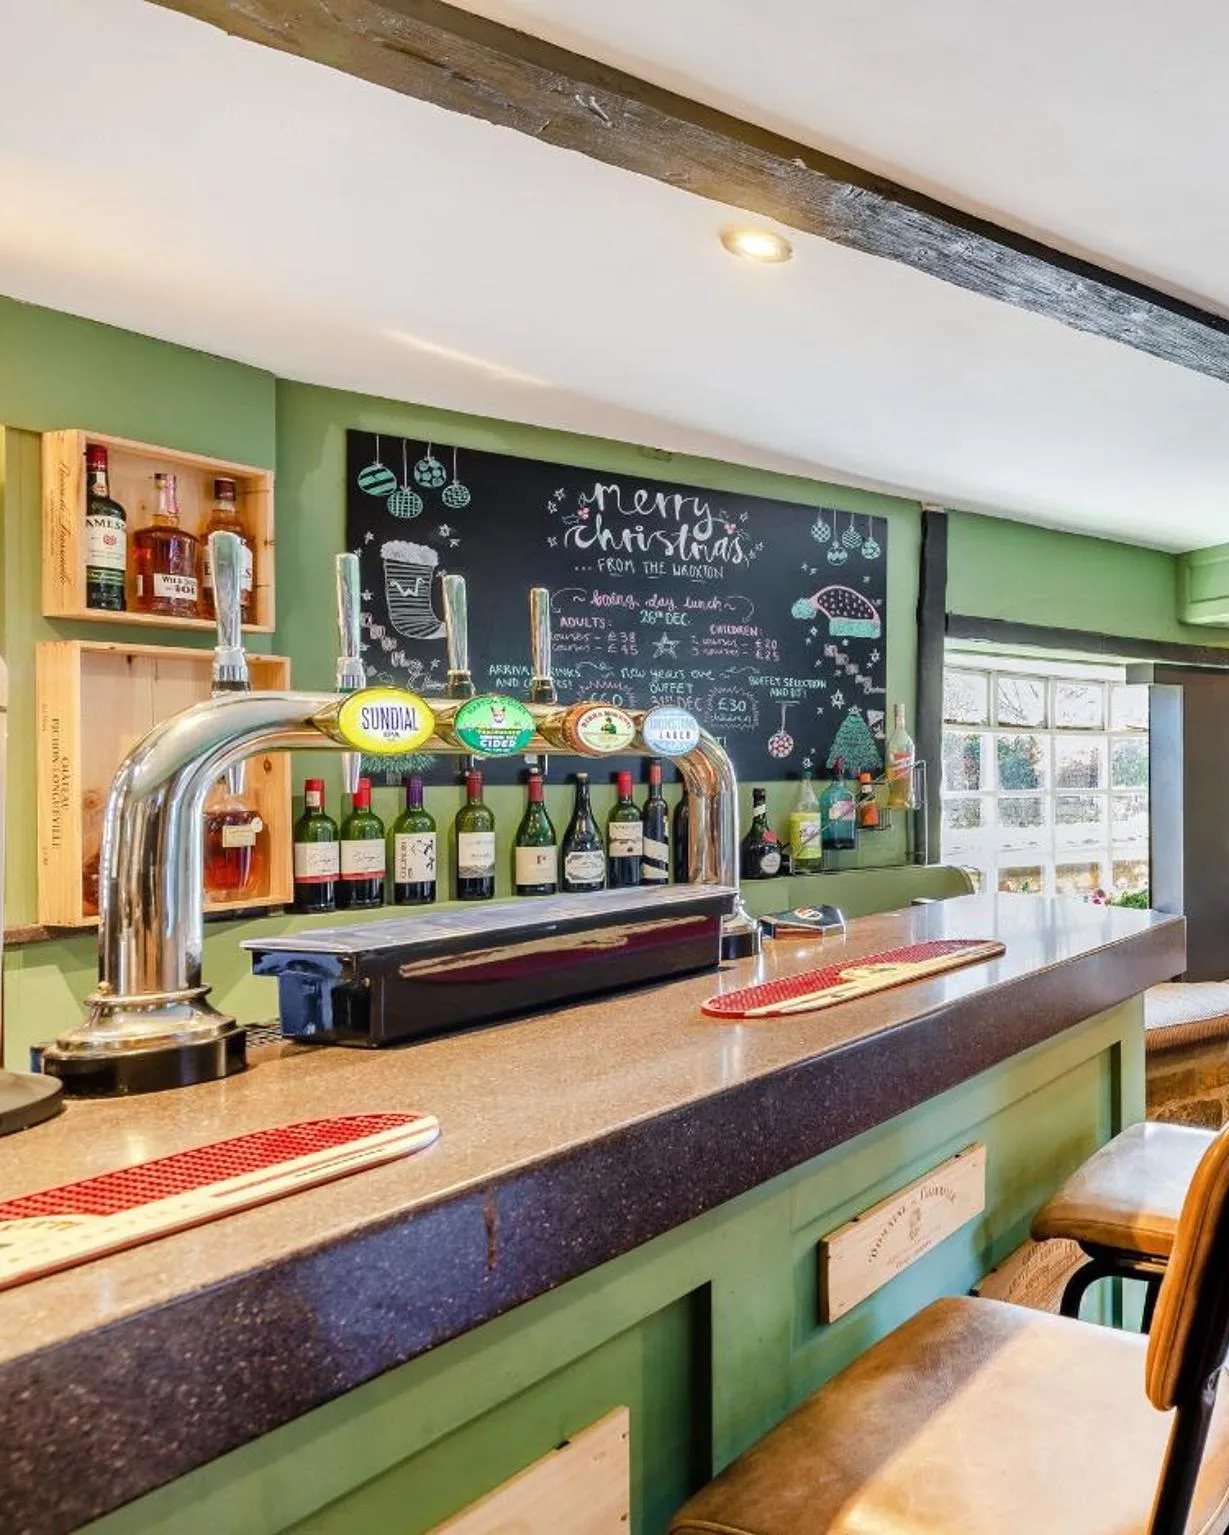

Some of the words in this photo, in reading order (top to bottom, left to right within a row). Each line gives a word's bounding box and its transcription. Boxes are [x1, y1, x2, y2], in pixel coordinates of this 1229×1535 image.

[598, 557, 636, 574] FROM
[642, 560, 667, 575] THE
[673, 563, 724, 579] WROXTON
[489, 664, 530, 676] ARRIVA
[495, 678, 519, 690] AND
[717, 696, 747, 712] £30
[361, 707, 419, 731] SUNDIAL
[479, 739, 517, 749] CIDER
